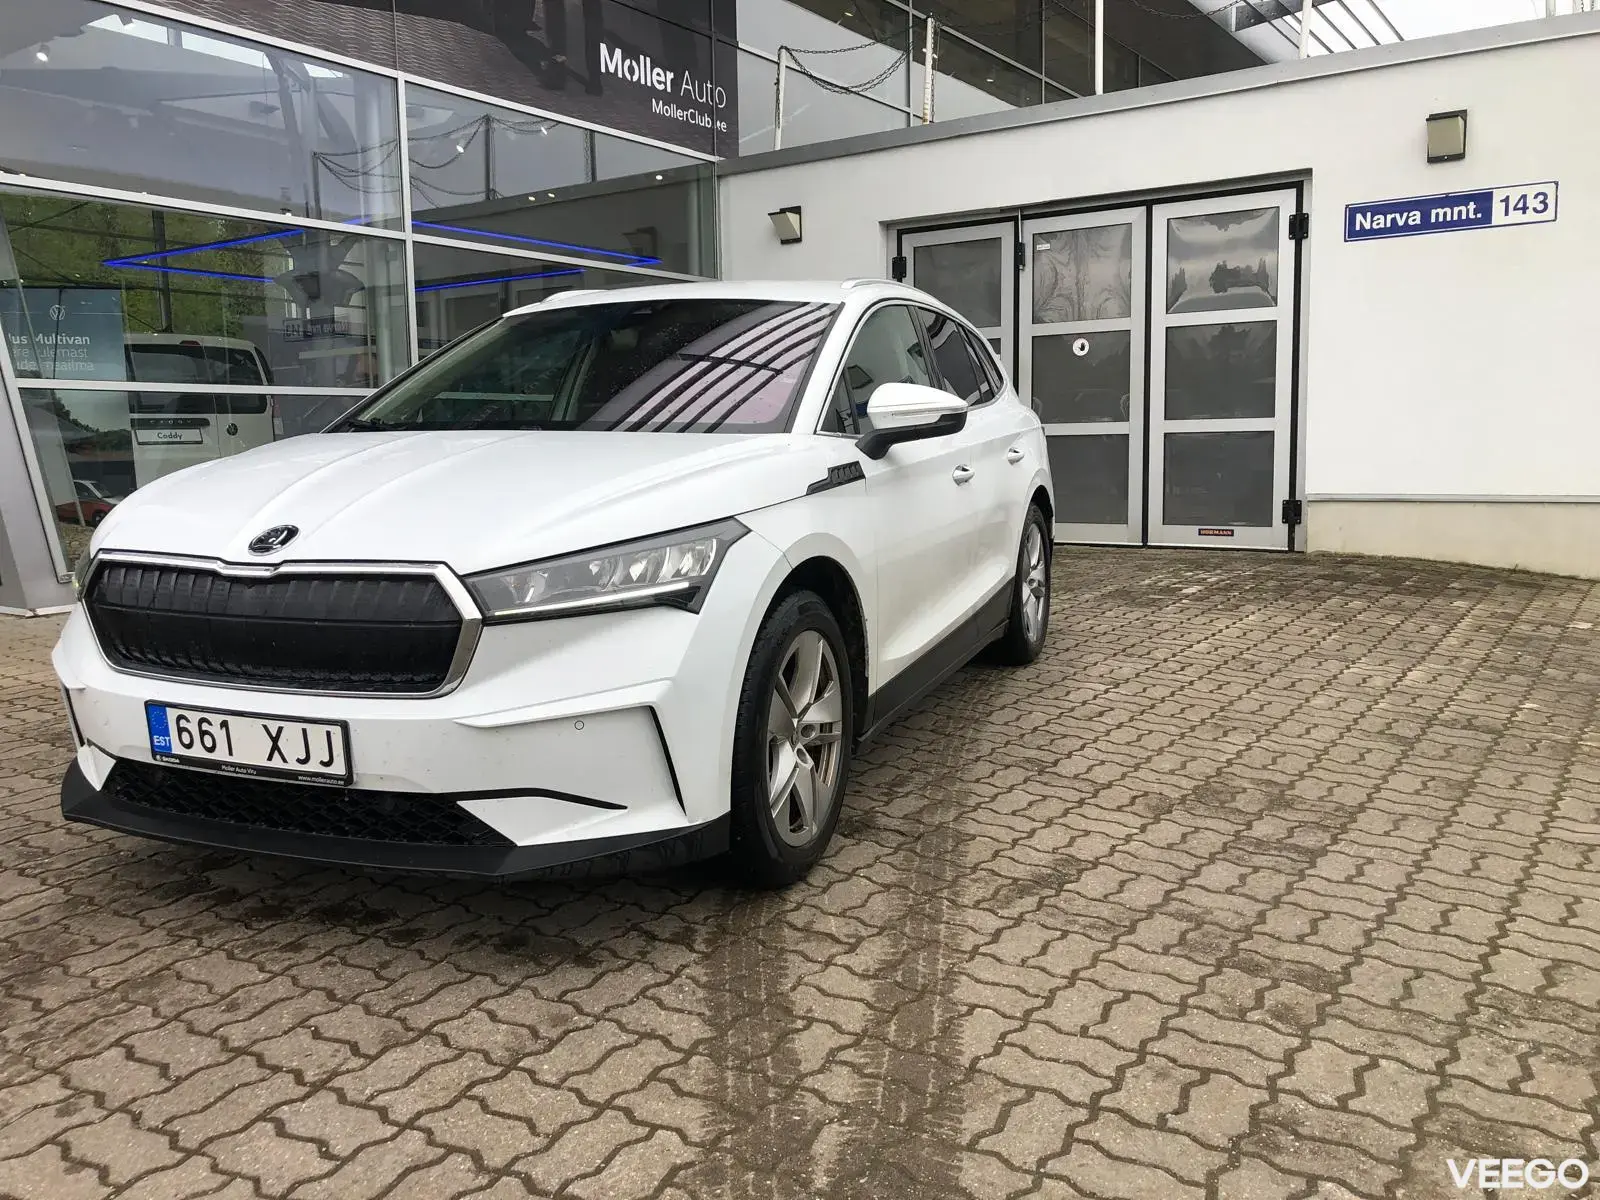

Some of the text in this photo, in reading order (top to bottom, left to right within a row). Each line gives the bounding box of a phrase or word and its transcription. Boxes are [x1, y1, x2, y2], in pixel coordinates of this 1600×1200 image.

[680, 70, 727, 108] Auto
[1355, 191, 1549, 231] Narva mnt. 143
[153, 735, 171, 747] EST
[175, 714, 335, 768] 661 XJJ
